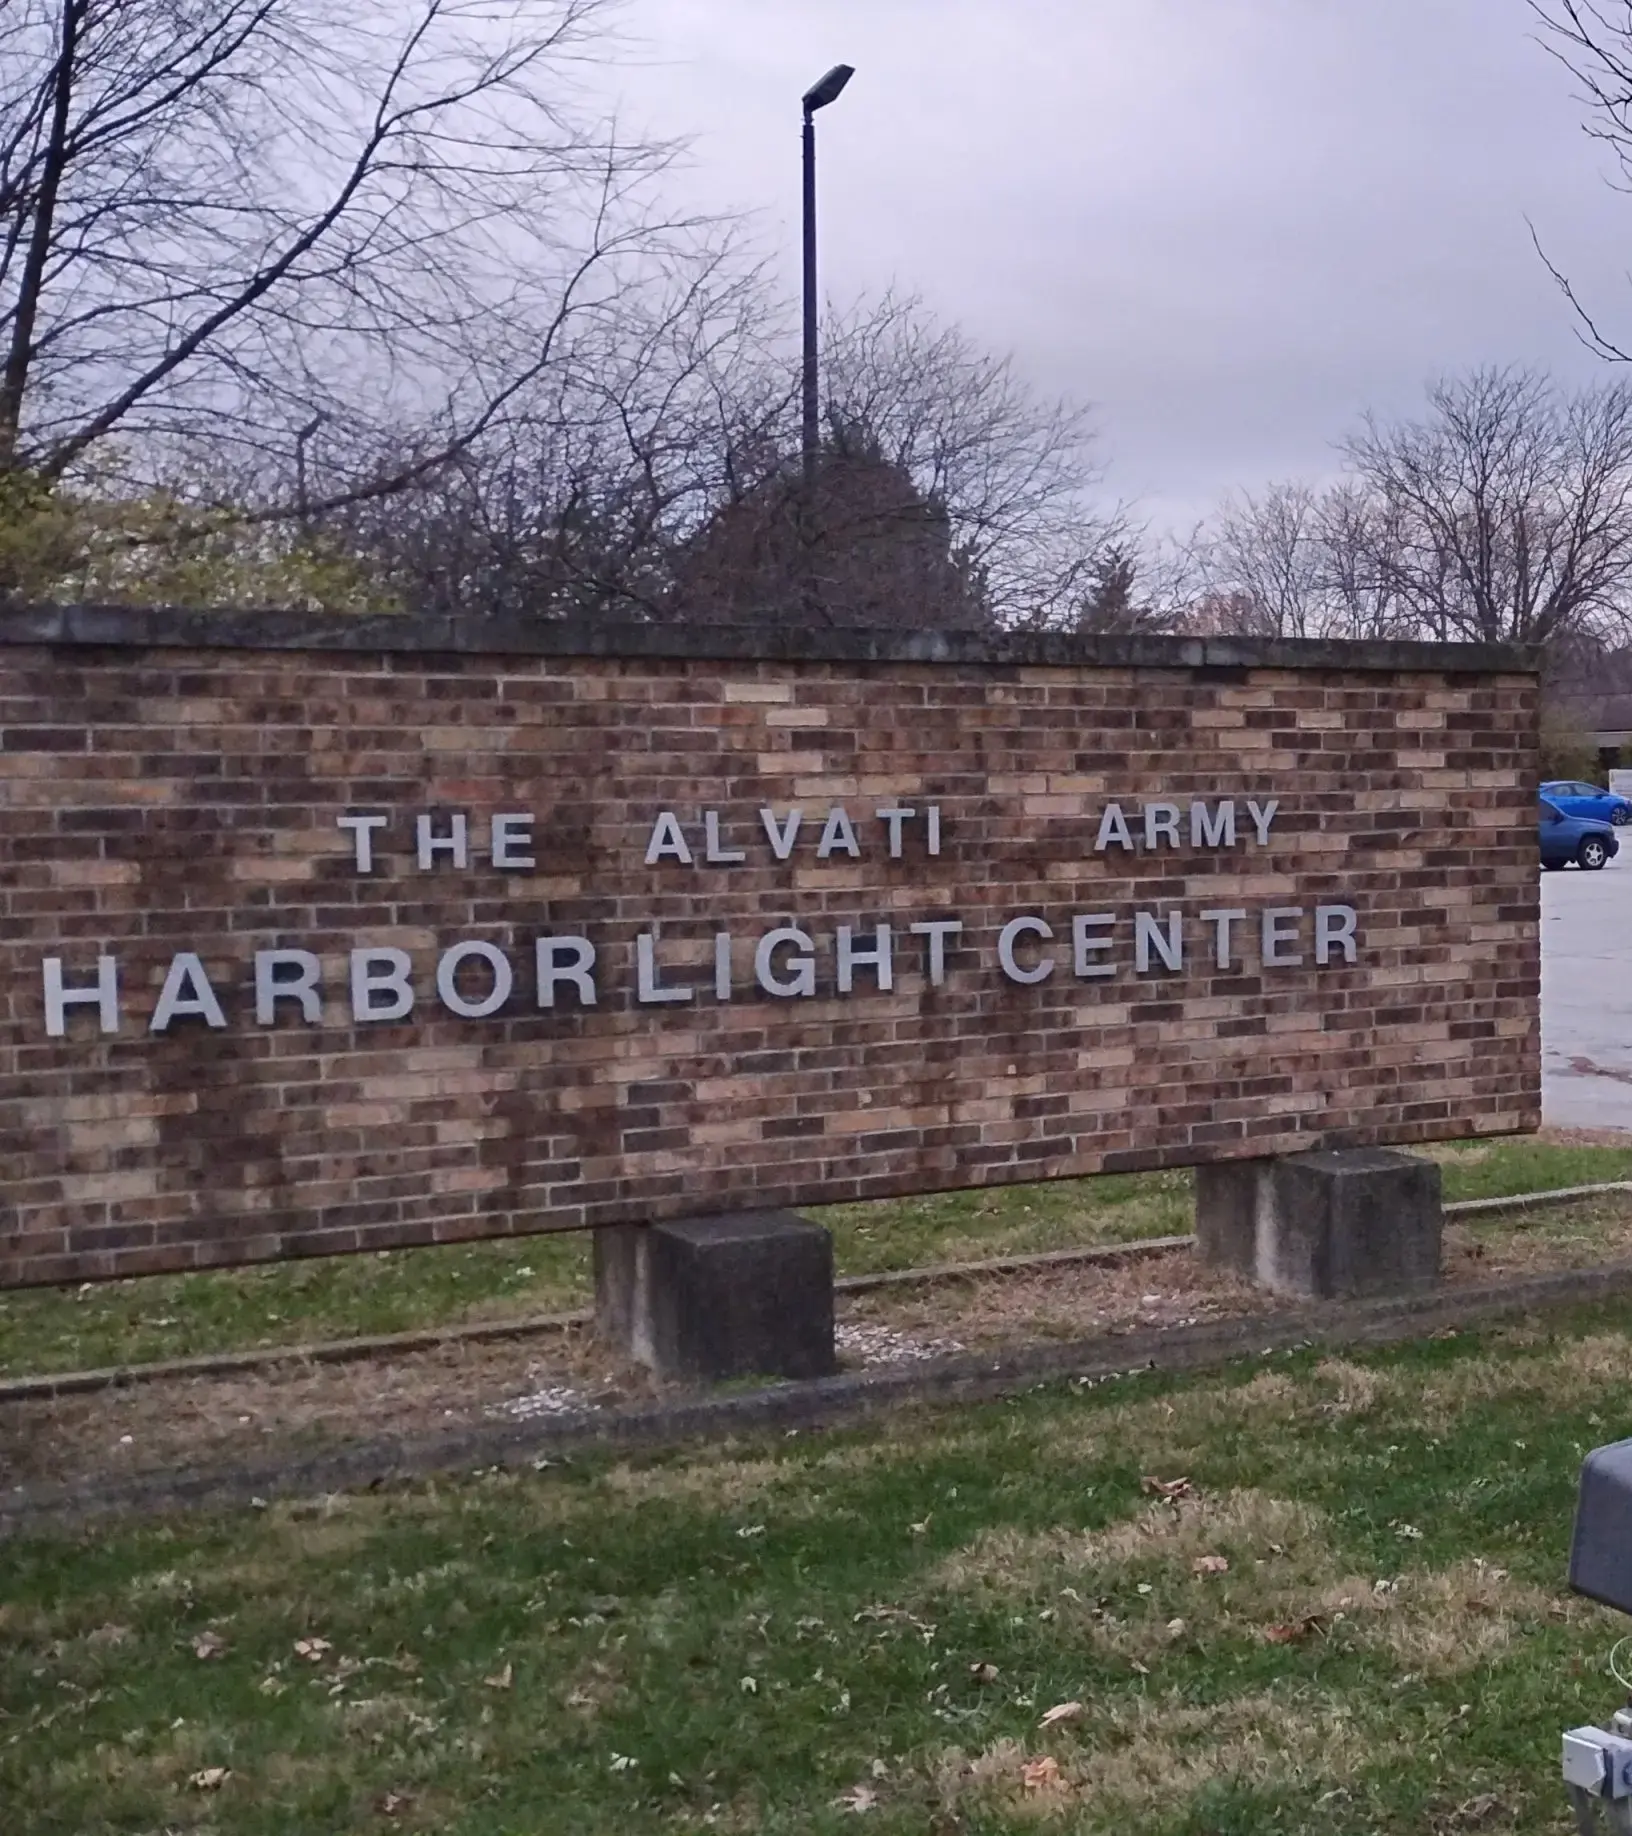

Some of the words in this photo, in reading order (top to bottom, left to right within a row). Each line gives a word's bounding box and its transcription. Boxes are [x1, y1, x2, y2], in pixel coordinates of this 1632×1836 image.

[336, 812, 538, 874] THE
[644, 806, 941, 866] ALVATI
[1094, 800, 1280, 852] ARMY
[997, 904, 1359, 985] CENTER
